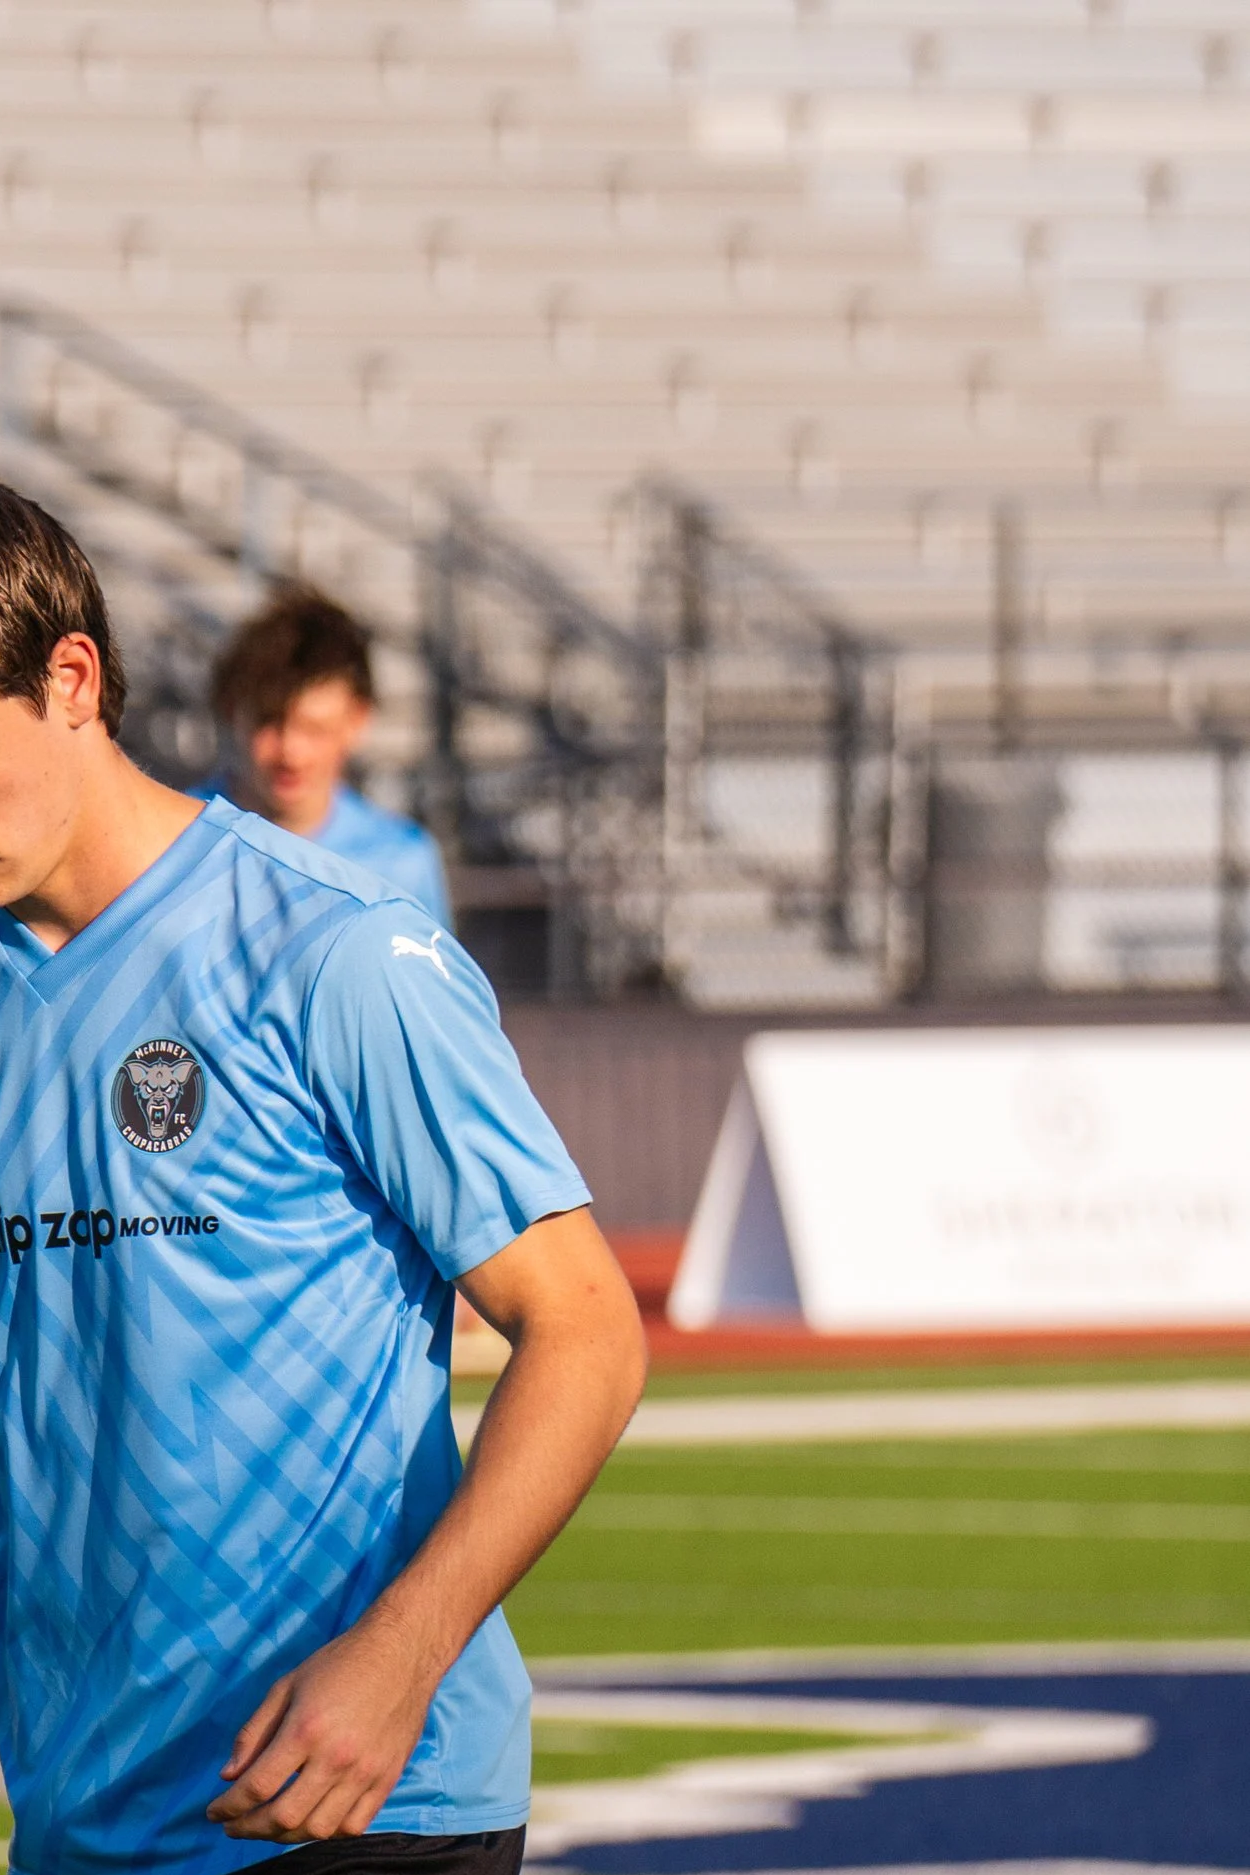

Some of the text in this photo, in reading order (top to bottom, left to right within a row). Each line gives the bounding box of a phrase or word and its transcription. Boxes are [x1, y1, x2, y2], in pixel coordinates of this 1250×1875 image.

[134, 1041, 188, 1059] McKINNEY
[174, 1113, 186, 1124] FC
[122, 1126, 192, 1152] CHUPACABRAS
[40, 1208, 115, 1259] zap
[119, 1215, 219, 1238] MOVING
